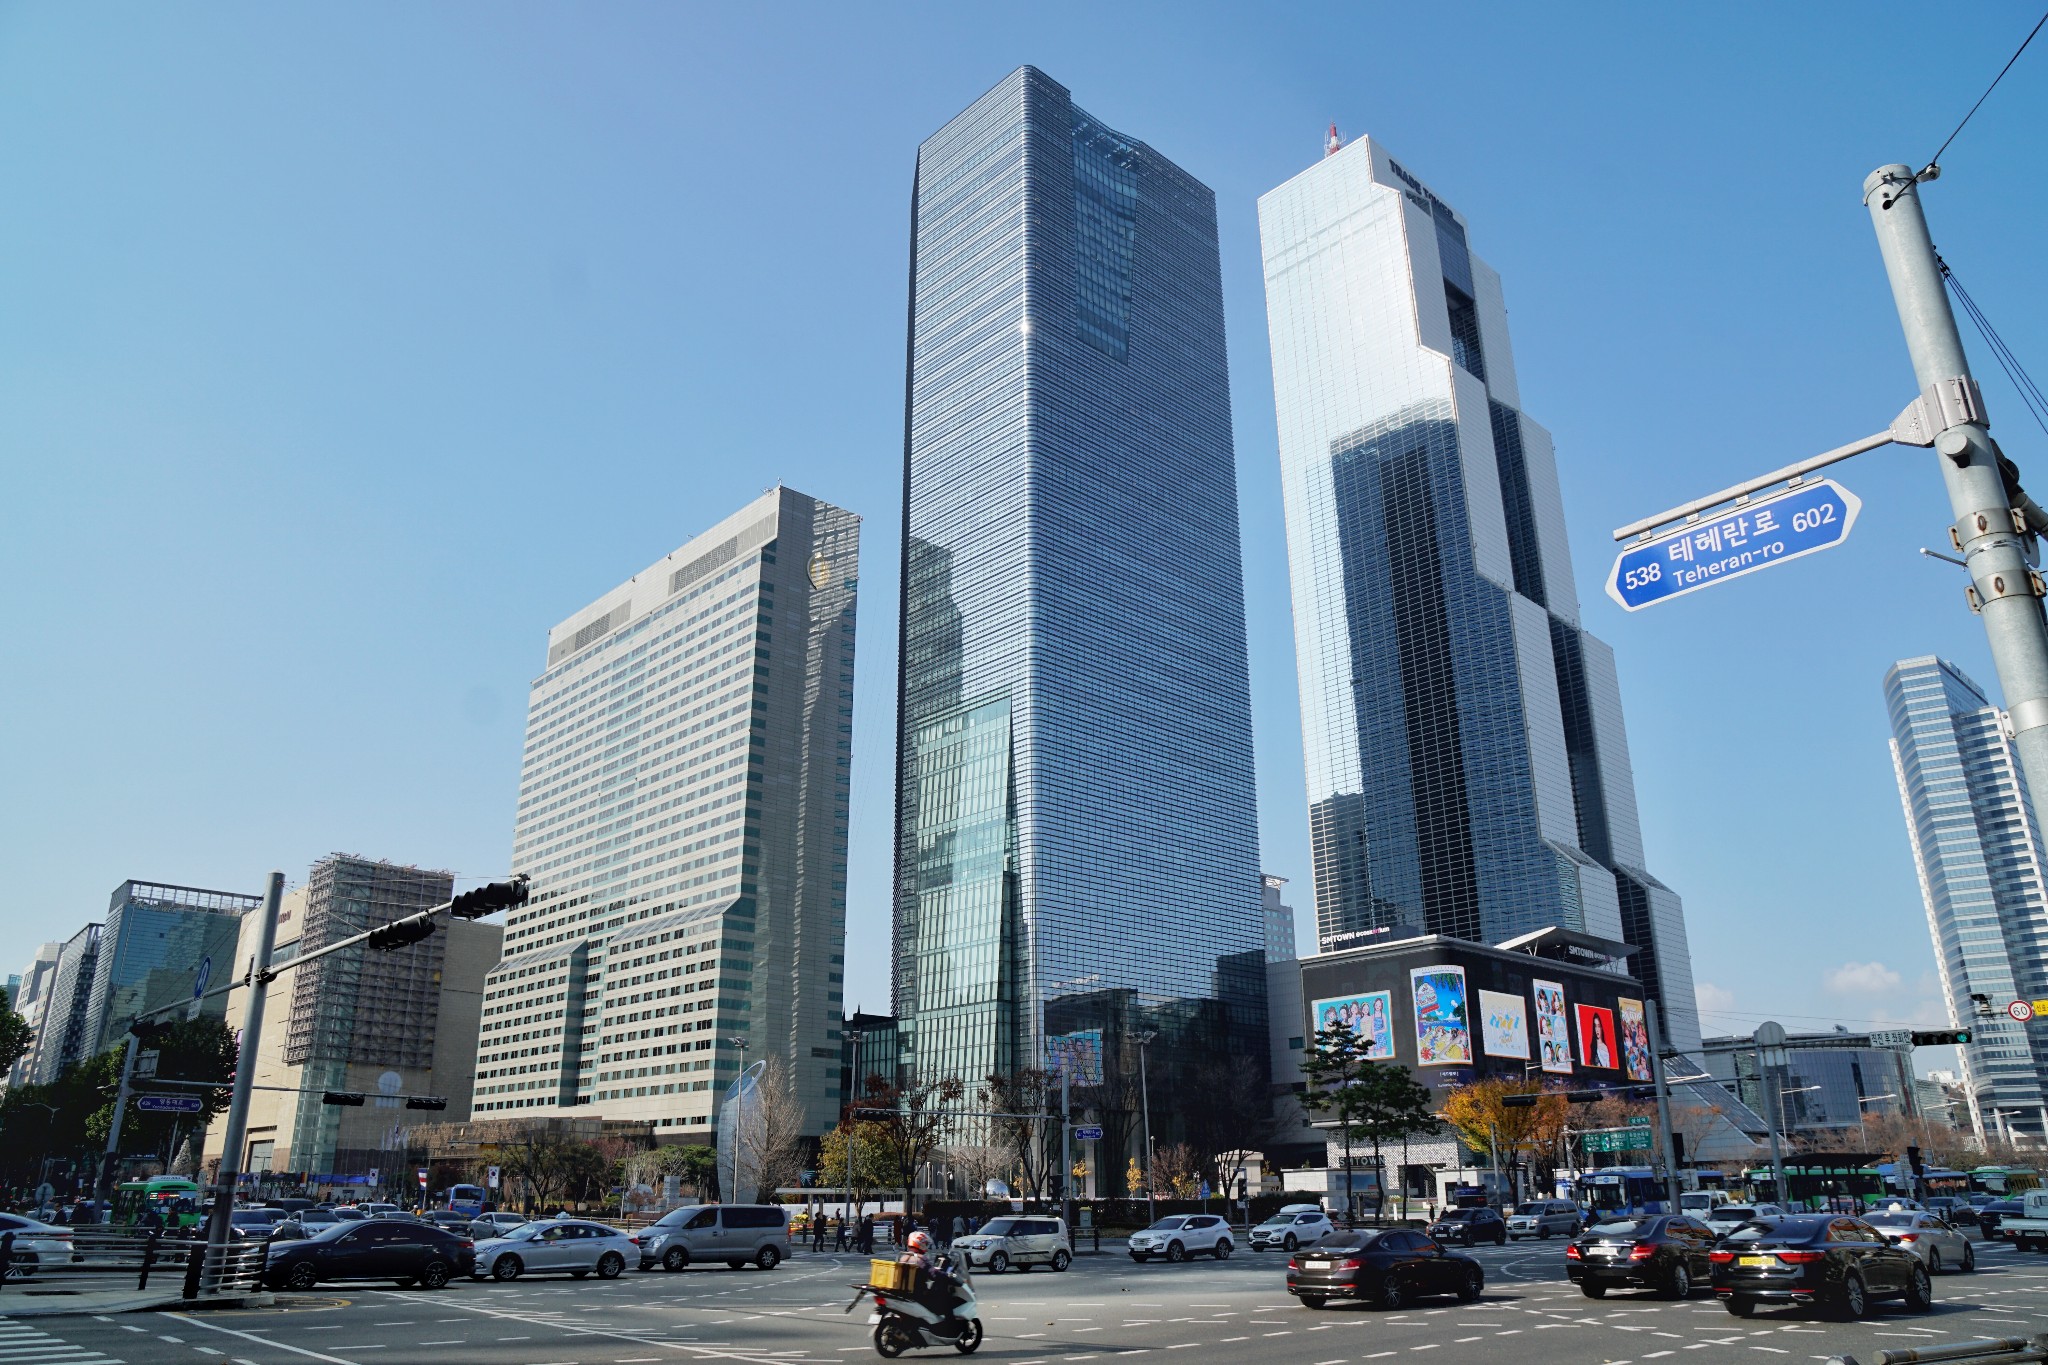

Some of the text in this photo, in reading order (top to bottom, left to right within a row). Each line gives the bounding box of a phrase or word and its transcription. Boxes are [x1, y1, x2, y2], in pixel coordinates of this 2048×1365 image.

[1389, 158, 1454, 218] TRADE TOWER
[1669, 503, 1837, 562] 테헤란로 602
[1625, 540, 1785, 590] 538 Teheran-ro
[1321, 932, 1355, 945] SMTOWN
[1568, 945, 1594, 960] SMTOWN
[2013, 1006, 2028, 1016] 60
[1871, 1031, 1911, 1046] 직진 후 좌회전
